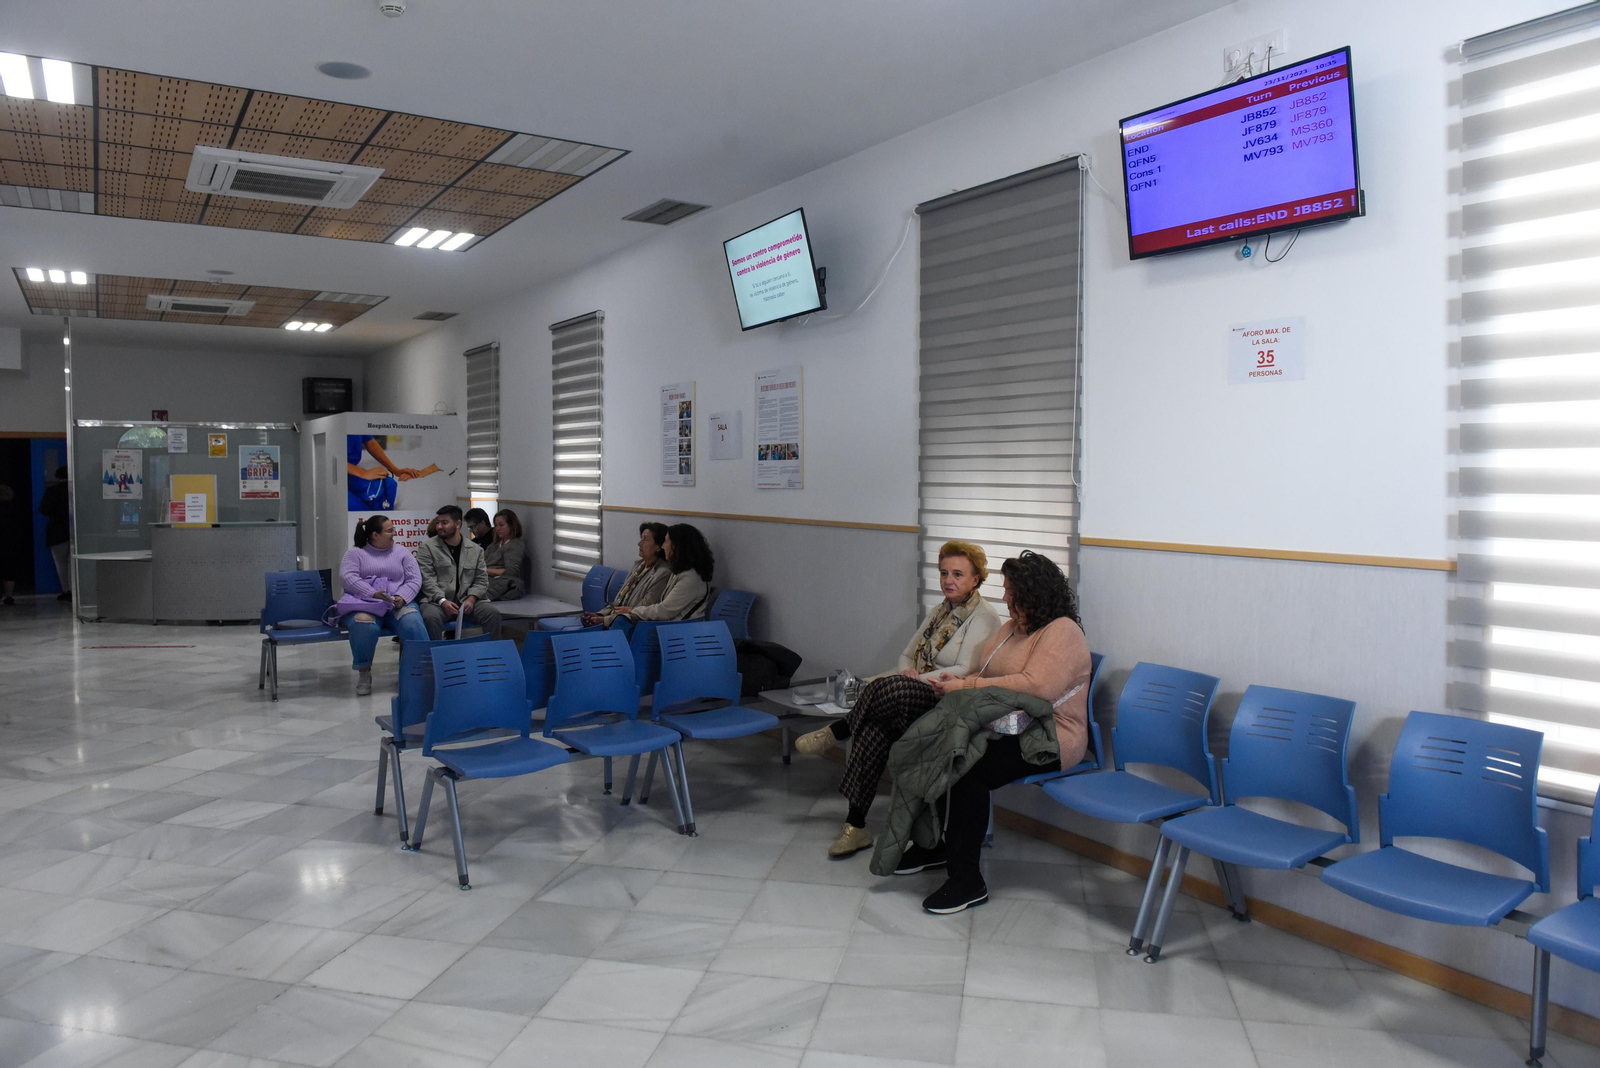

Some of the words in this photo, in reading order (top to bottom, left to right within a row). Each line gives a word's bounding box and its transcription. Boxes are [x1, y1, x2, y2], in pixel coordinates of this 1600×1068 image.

[1264, 69, 1308, 86] 23/11/2023
[1315, 60, 1337, 70] 10:35
[1126, 126, 1164, 141] Location
[1246, 90, 1272, 104] Turn
[1289, 71, 1341, 92] Previous
[1127, 145, 1149, 157] END
[1240, 106, 1277, 124] JB852
[1289, 92, 1327, 110] JB852
[1128, 154, 1156, 169] QFN5
[1242, 120, 1277, 137] JF879
[1290, 106, 1327, 123] JF879
[1129, 169, 1154, 181] Cons
[1157, 165, 1162, 174] 1
[1243, 133, 1278, 150] JV634
[1291, 118, 1333, 137] MS360
[1130, 179, 1158, 192] QFN1
[1244, 145, 1283, 163] MV793
[1292, 132, 1335, 150] MV793
[1187, 223, 1215, 238] Last
[1293, 198, 1344, 217] JB852
[732, 256, 746, 266] Somos
[753, 248, 767, 258] centro
[768, 233, 802, 252] comprometido
[737, 267, 751, 276] contra
[756, 257, 776, 269] violencia
[776, 254, 783, 262] de
[783, 248, 801, 261] género
[1249, 369, 1282, 377] PERSONAS
[1257, 350, 1274, 364] 35
[248, 468, 273, 476] GRIPE
